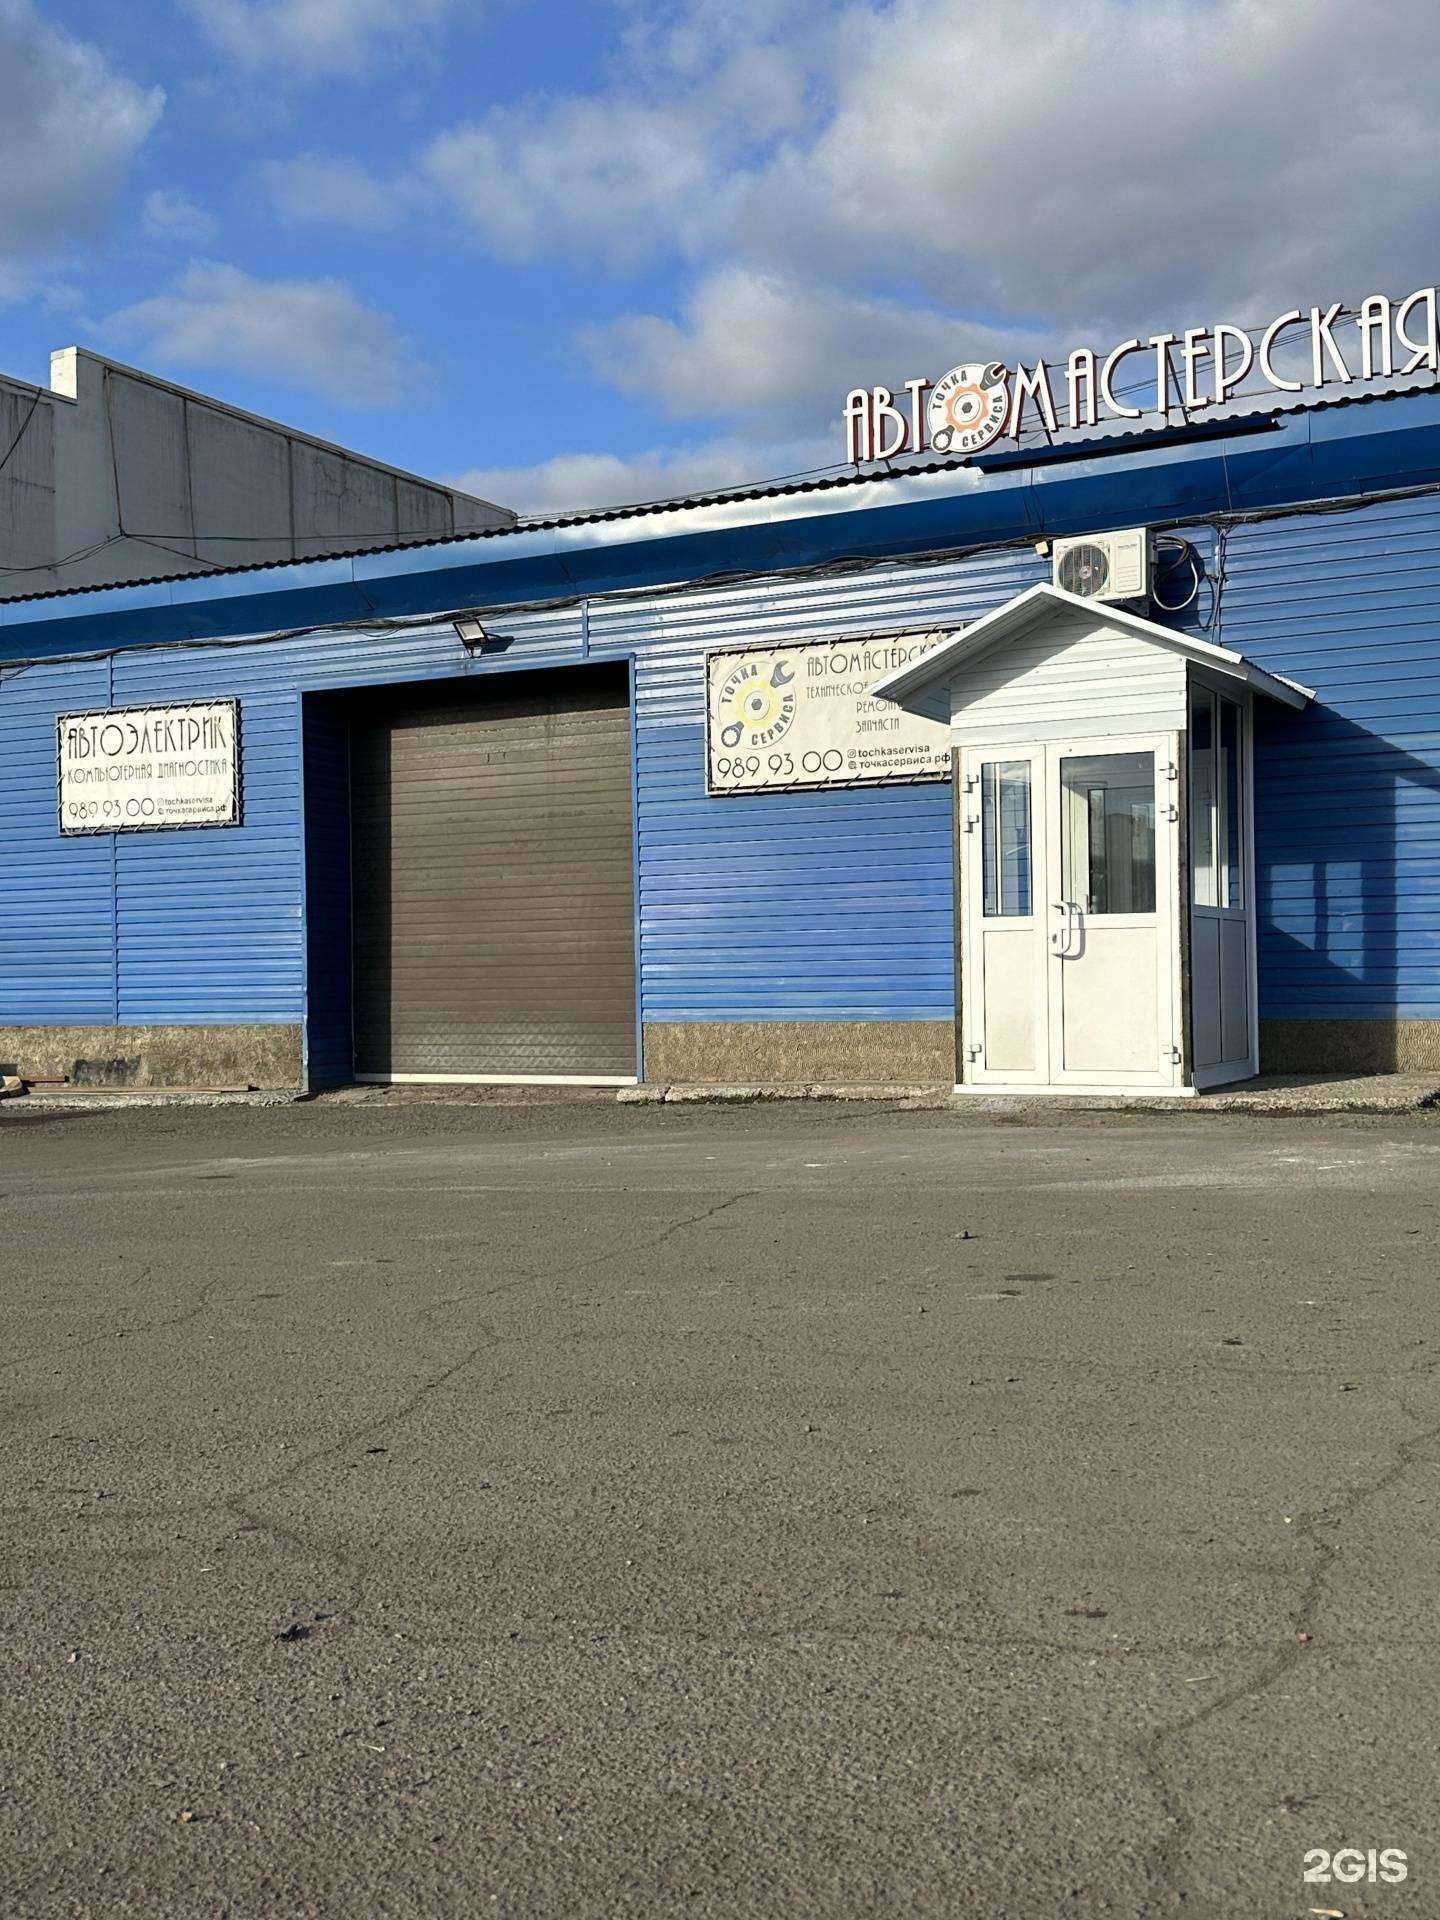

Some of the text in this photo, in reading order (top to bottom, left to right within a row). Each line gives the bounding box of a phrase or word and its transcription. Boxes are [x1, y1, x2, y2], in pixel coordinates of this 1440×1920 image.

[932, 370, 967, 409] ТОЧКА
[962, 395, 1003, 447] СЕРВИСА
[722, 664, 758, 704] ТОЧКА
[67, 716, 227, 759] АВТОЭЛЕКТРИК
[751, 694, 794, 746] СЕРВИСА
[855, 718, 900, 733] ЗАПЧАСТИ
[67, 758, 228, 784] КОМПЬЮТЕРНАЯ ДИАГНОСТИКА
[717, 749, 843, 778] 989 93 00
[68, 797, 155, 819] 989 93 00
